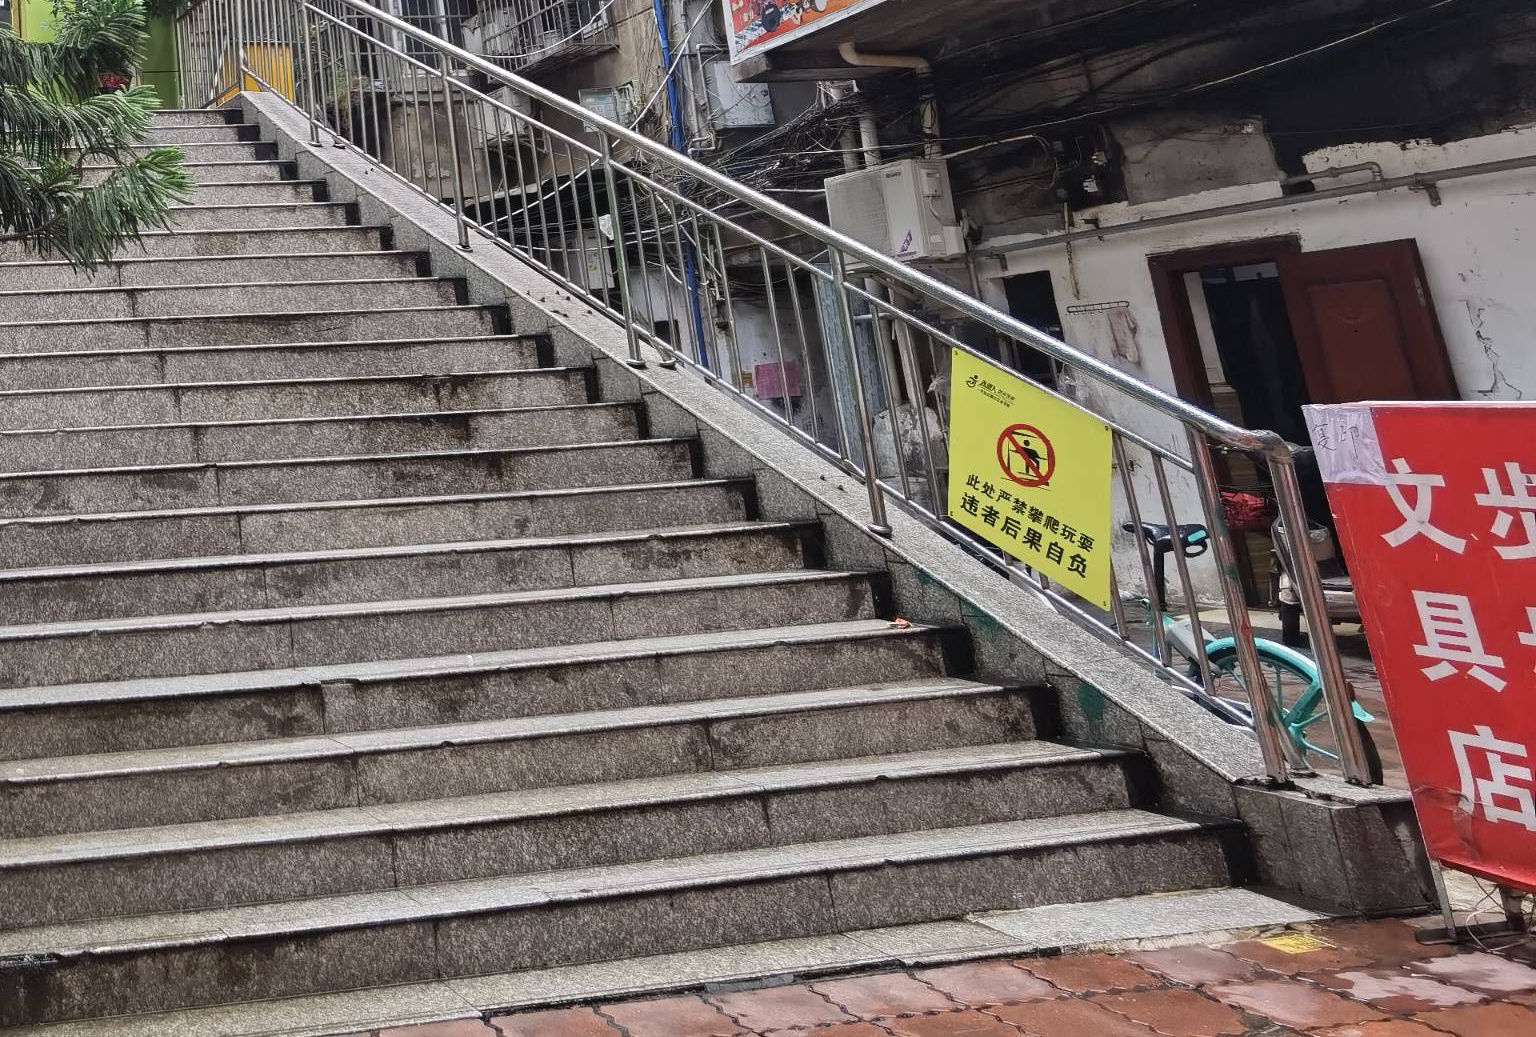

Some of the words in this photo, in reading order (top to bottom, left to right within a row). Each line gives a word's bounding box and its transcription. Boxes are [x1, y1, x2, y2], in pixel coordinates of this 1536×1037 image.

[960, 492, 1089, 579] 违者后果自负
[966, 473, 1096, 552] 此处严禁攀爬玩耍
